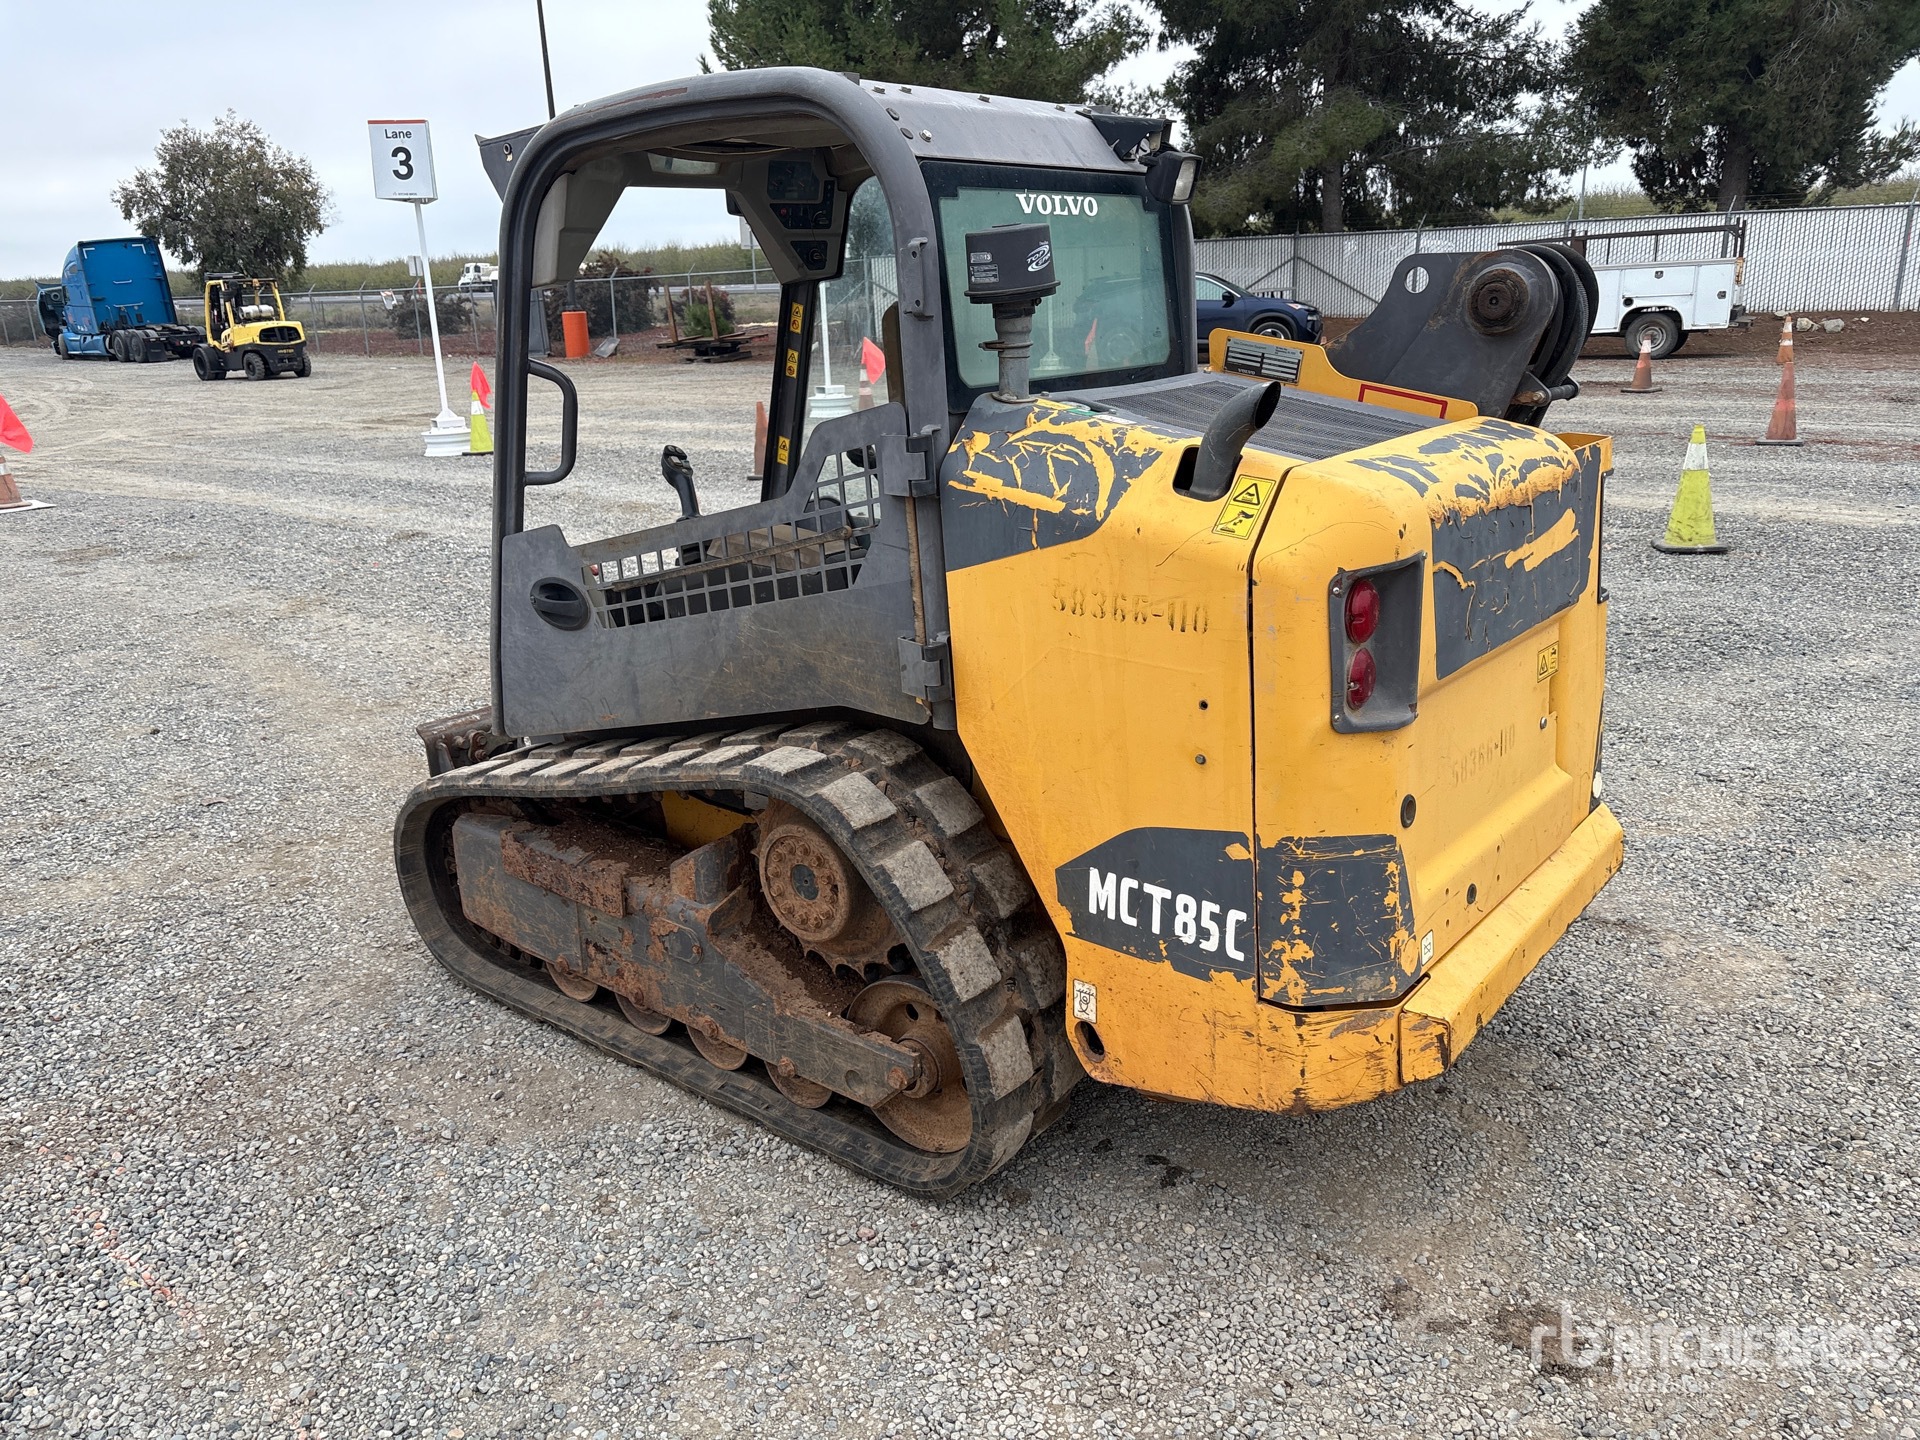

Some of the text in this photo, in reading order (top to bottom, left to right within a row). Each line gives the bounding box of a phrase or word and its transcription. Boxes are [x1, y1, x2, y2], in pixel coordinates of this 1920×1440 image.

[384, 128, 412, 139] Lane
[391, 146, 414, 180] 3
[1015, 193, 1098, 217] VOLVO
[1088, 866, 1248, 962] MCT85C
